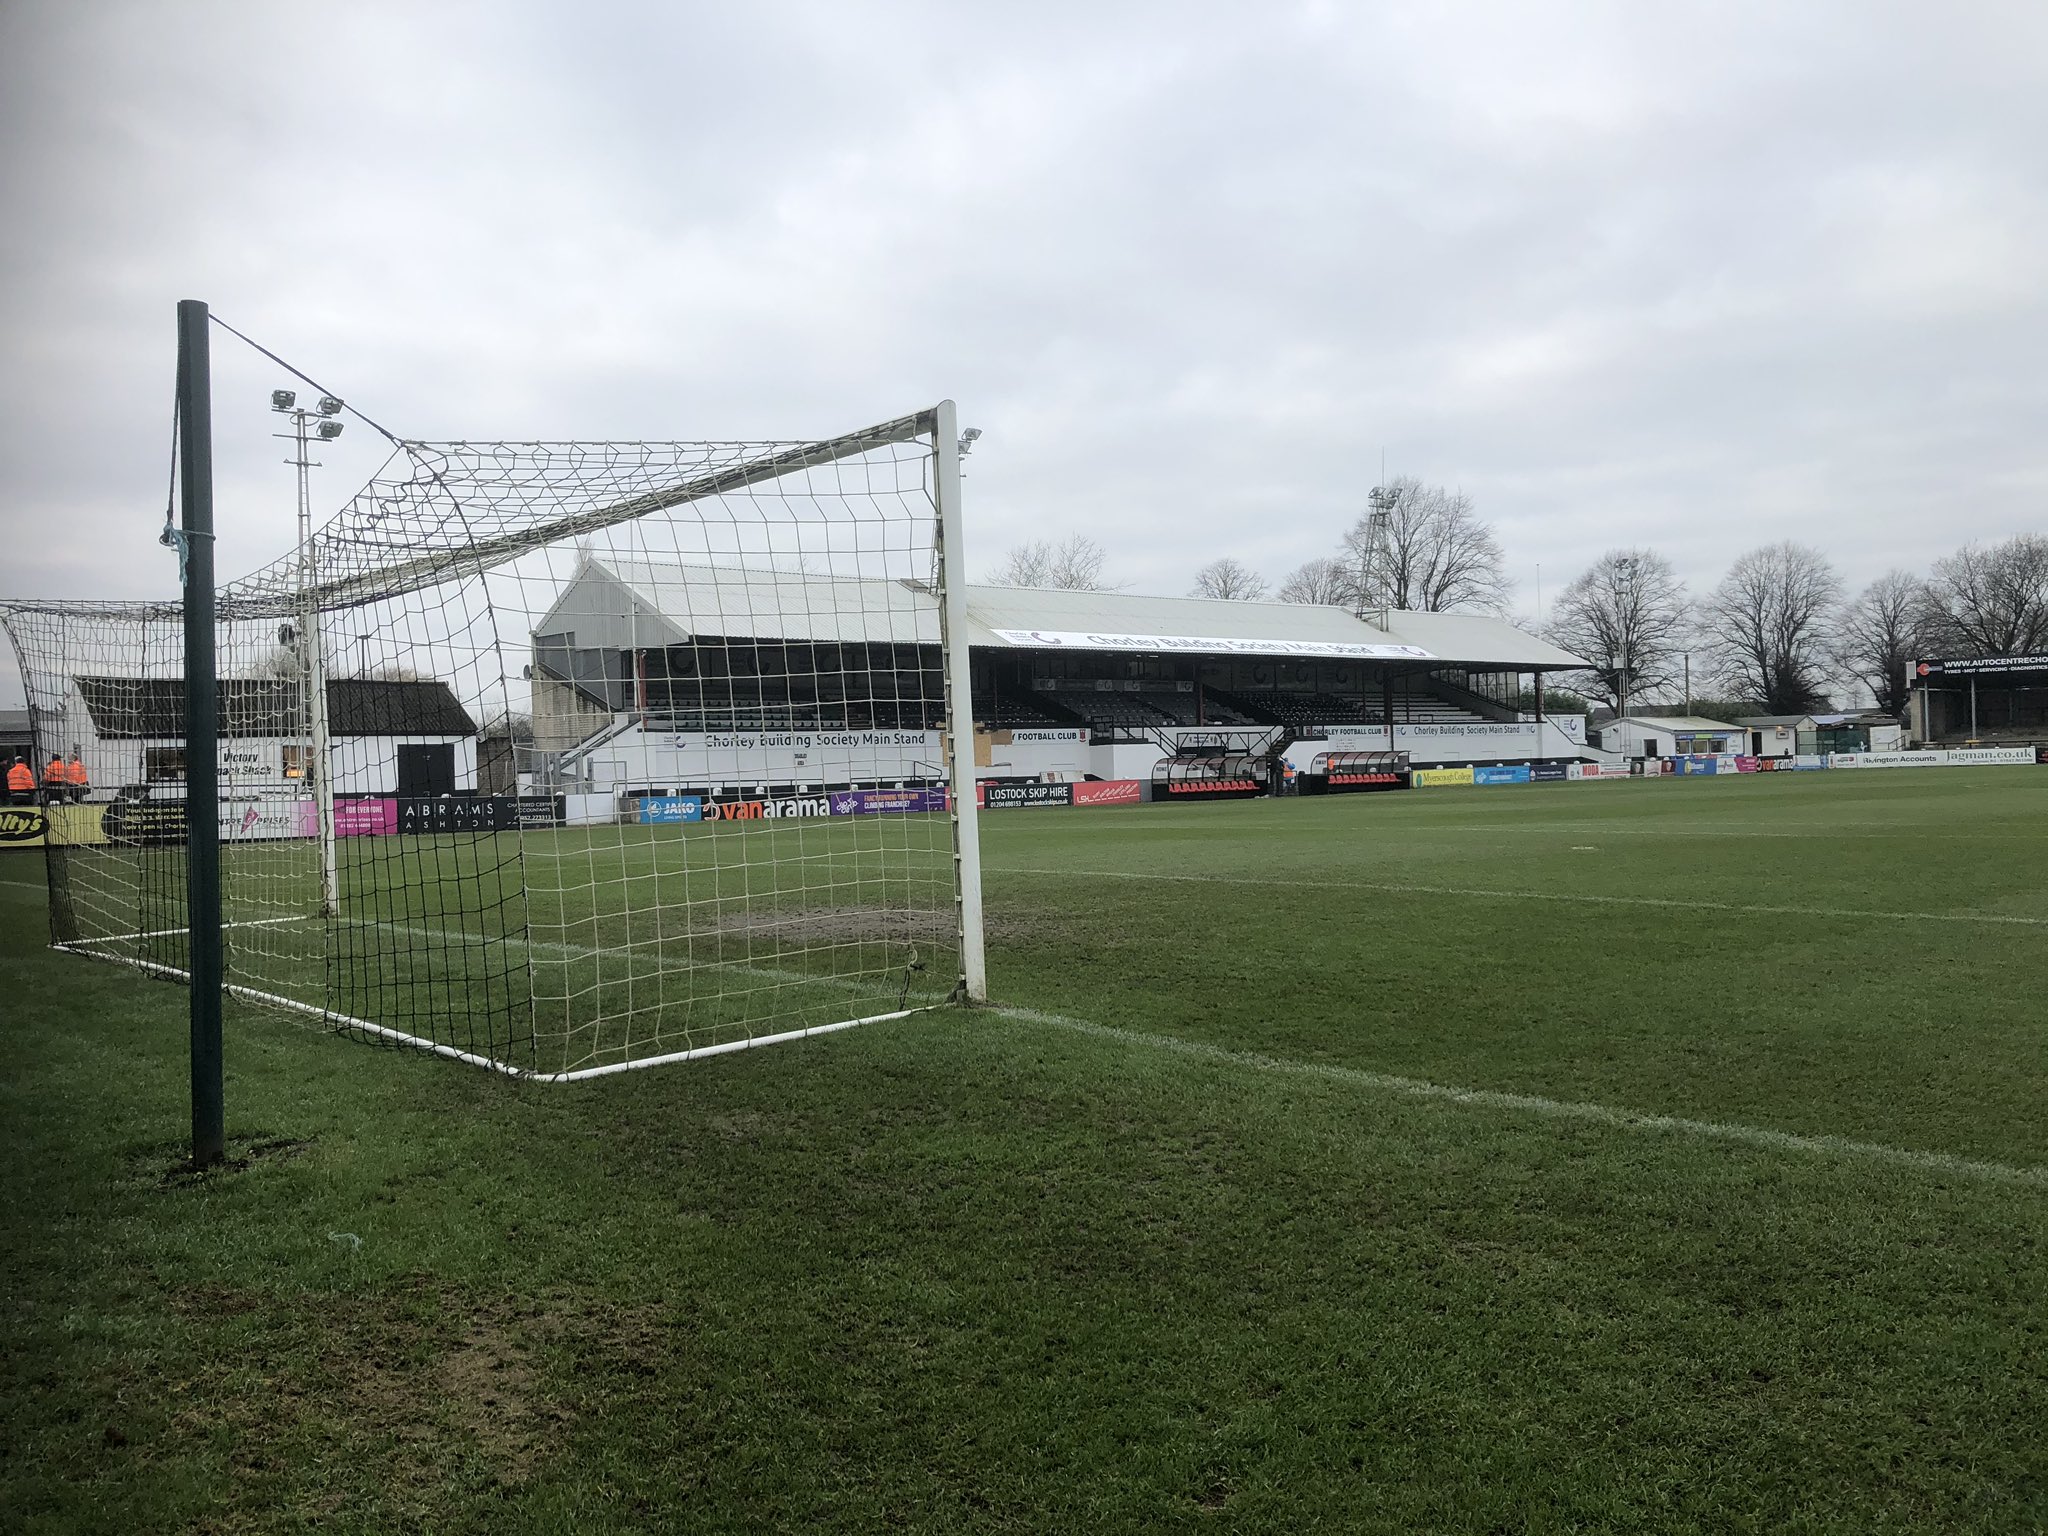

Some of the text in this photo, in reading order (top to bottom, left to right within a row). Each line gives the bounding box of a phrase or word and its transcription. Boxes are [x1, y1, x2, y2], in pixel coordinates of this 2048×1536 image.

[1087, 635, 1161, 649] Chorley
[1159, 638, 1232, 652] Building
[1230, 641, 1288, 654] Society
[1018, 732, 1056, 741] FOOTBALL
[1058, 732, 1077, 740] CLUB
[1340, 728, 1367, 736] FOOTBALL
[1414, 725, 1520, 736] Chorley Building Society Main Stand
[706, 733, 924, 749] Chorley Building Society Main Stand
[224, 753, 258, 763] Victory
[1900, 754, 1937, 763] Accounts
[1946, 748, 2032, 762] Jagman.co.uk
[1582, 765, 1599, 776] MODA
[1762, 758, 1794, 771] vanarama
[241, 766, 271, 776] Shack
[1423, 771, 1472, 783] Myerscough College
[990, 786, 1068, 800] LOSTOCK SKIP HIRE
[664, 802, 695, 815] JAKO
[722, 798, 831, 820] vanarama
